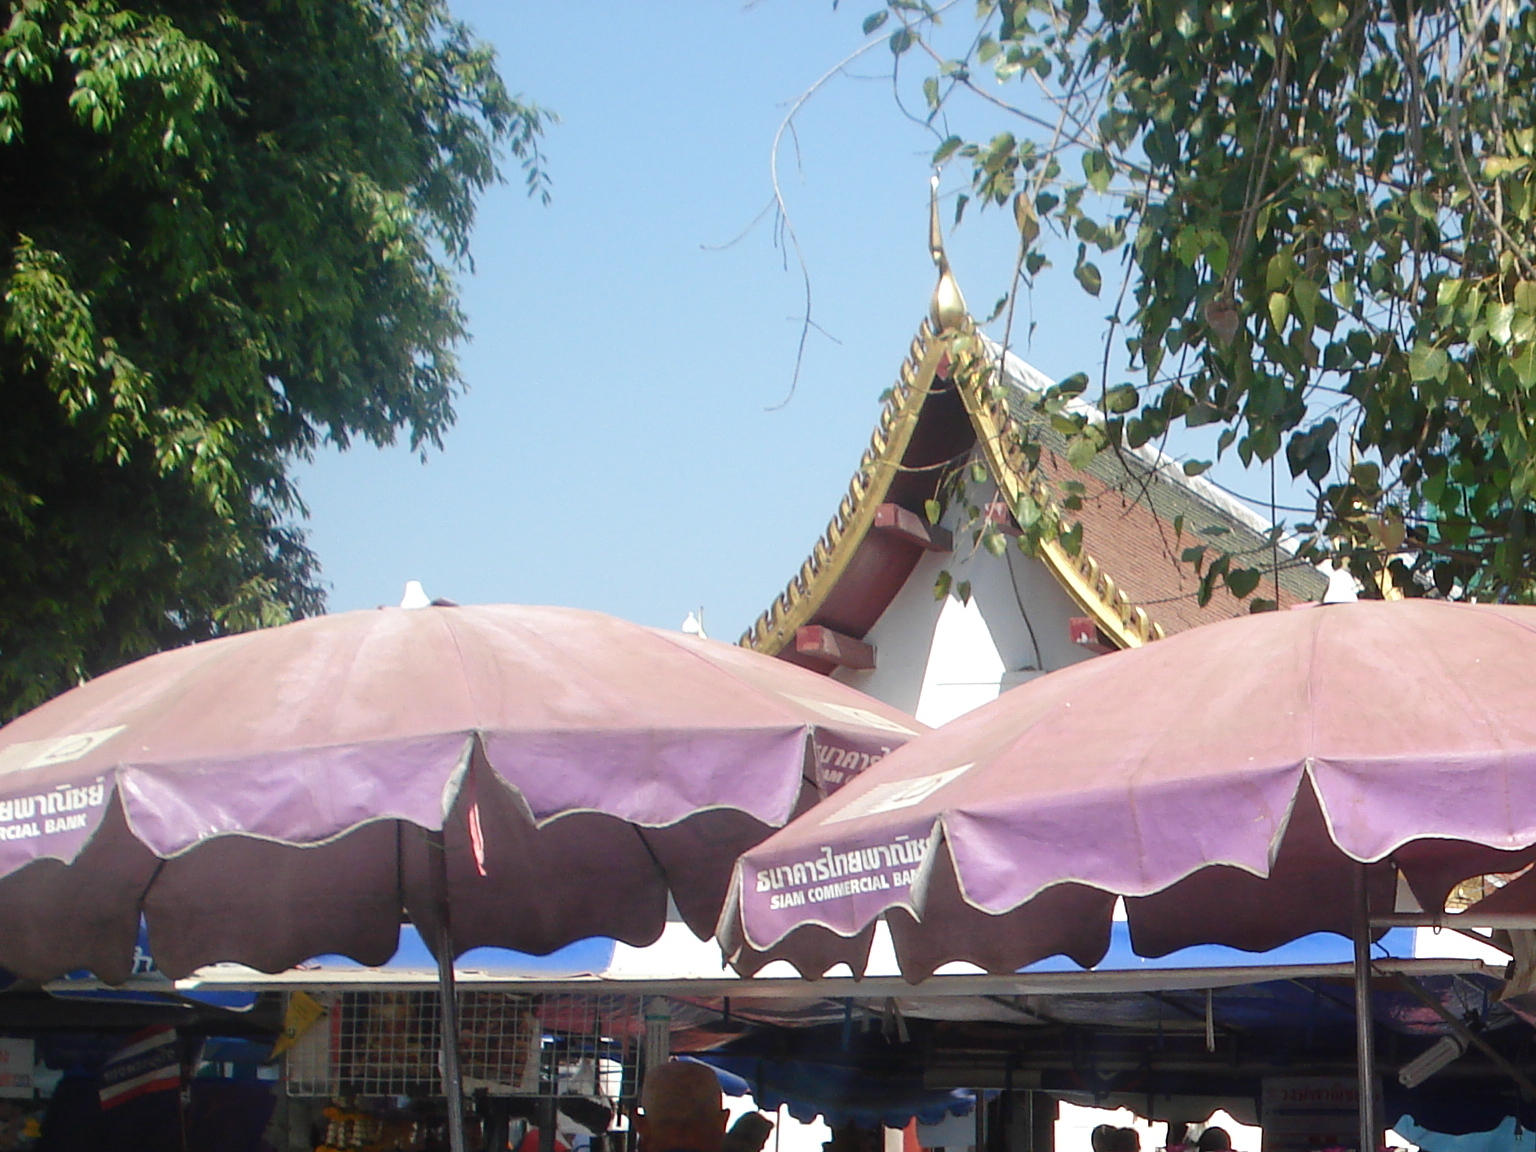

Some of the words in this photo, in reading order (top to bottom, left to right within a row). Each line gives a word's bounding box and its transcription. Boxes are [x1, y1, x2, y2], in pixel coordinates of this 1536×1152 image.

[45, 813, 88, 834] BANK
[770, 889, 805, 910] SIAM
[808, 875, 889, 904] COMMERCIAL
